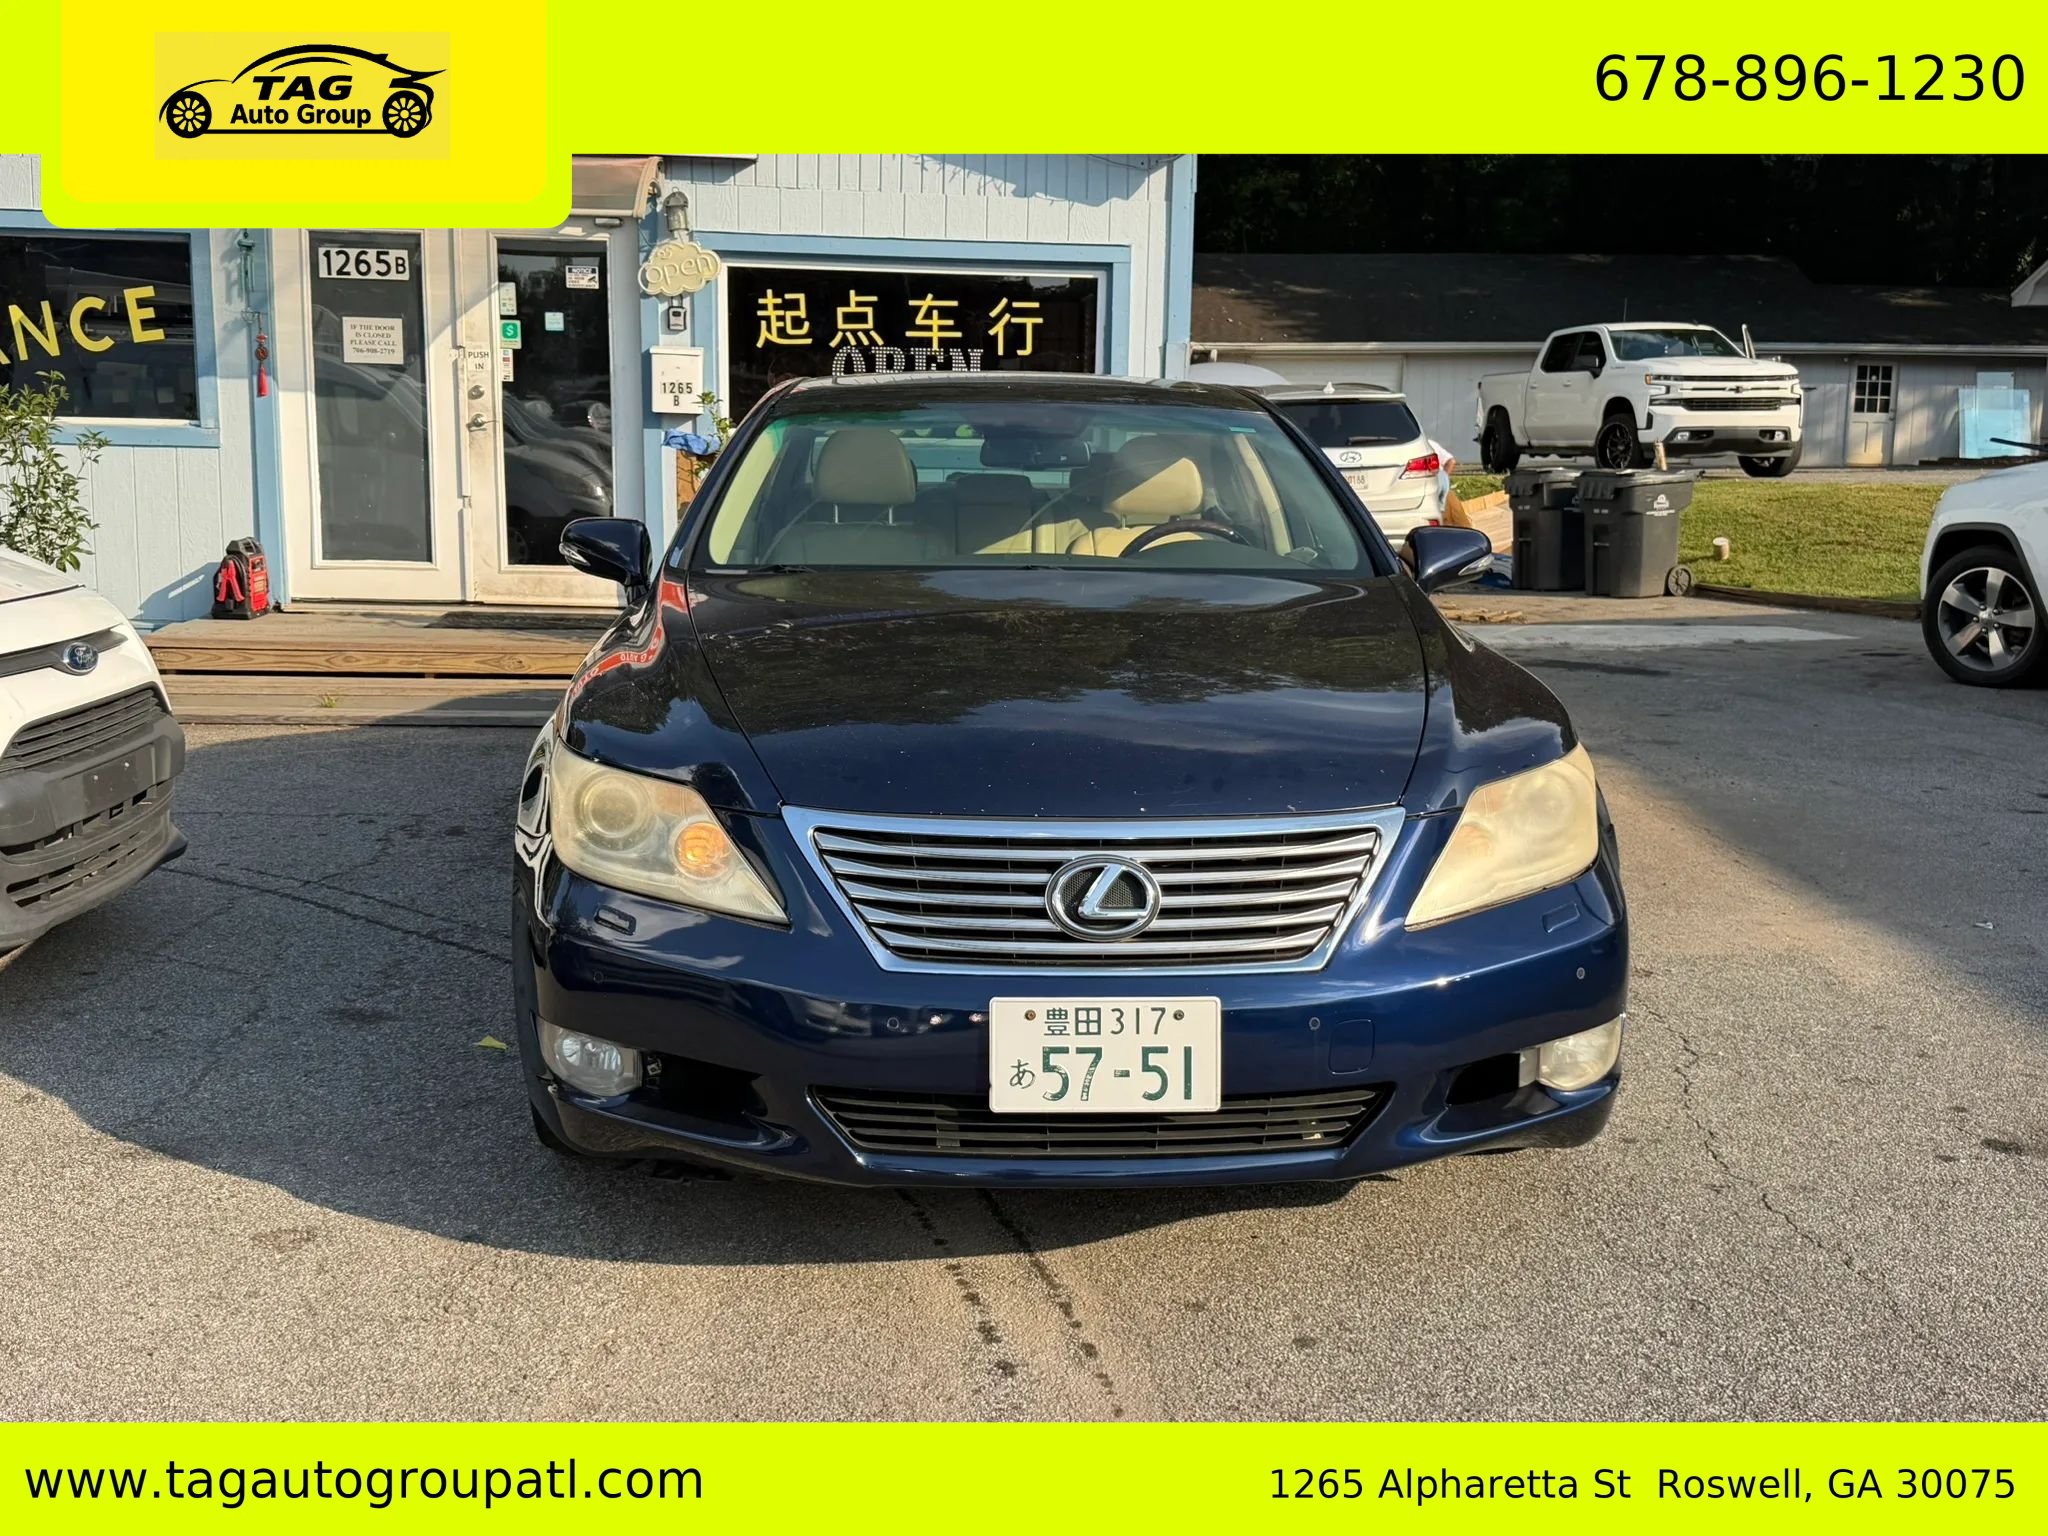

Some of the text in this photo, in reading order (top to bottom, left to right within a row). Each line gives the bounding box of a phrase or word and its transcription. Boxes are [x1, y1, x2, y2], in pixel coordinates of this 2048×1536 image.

[645, 253, 714, 288] open
[755, 288, 1045, 357] 起点车行
[363, 331, 392, 339] CLOSED
[468, 351, 489, 359] PUSH
[474, 362, 484, 370] IN
[662, 382, 693, 394] 1265
[673, 394, 680, 407] B
[1042, 1046, 1193, 1102] 57-51
